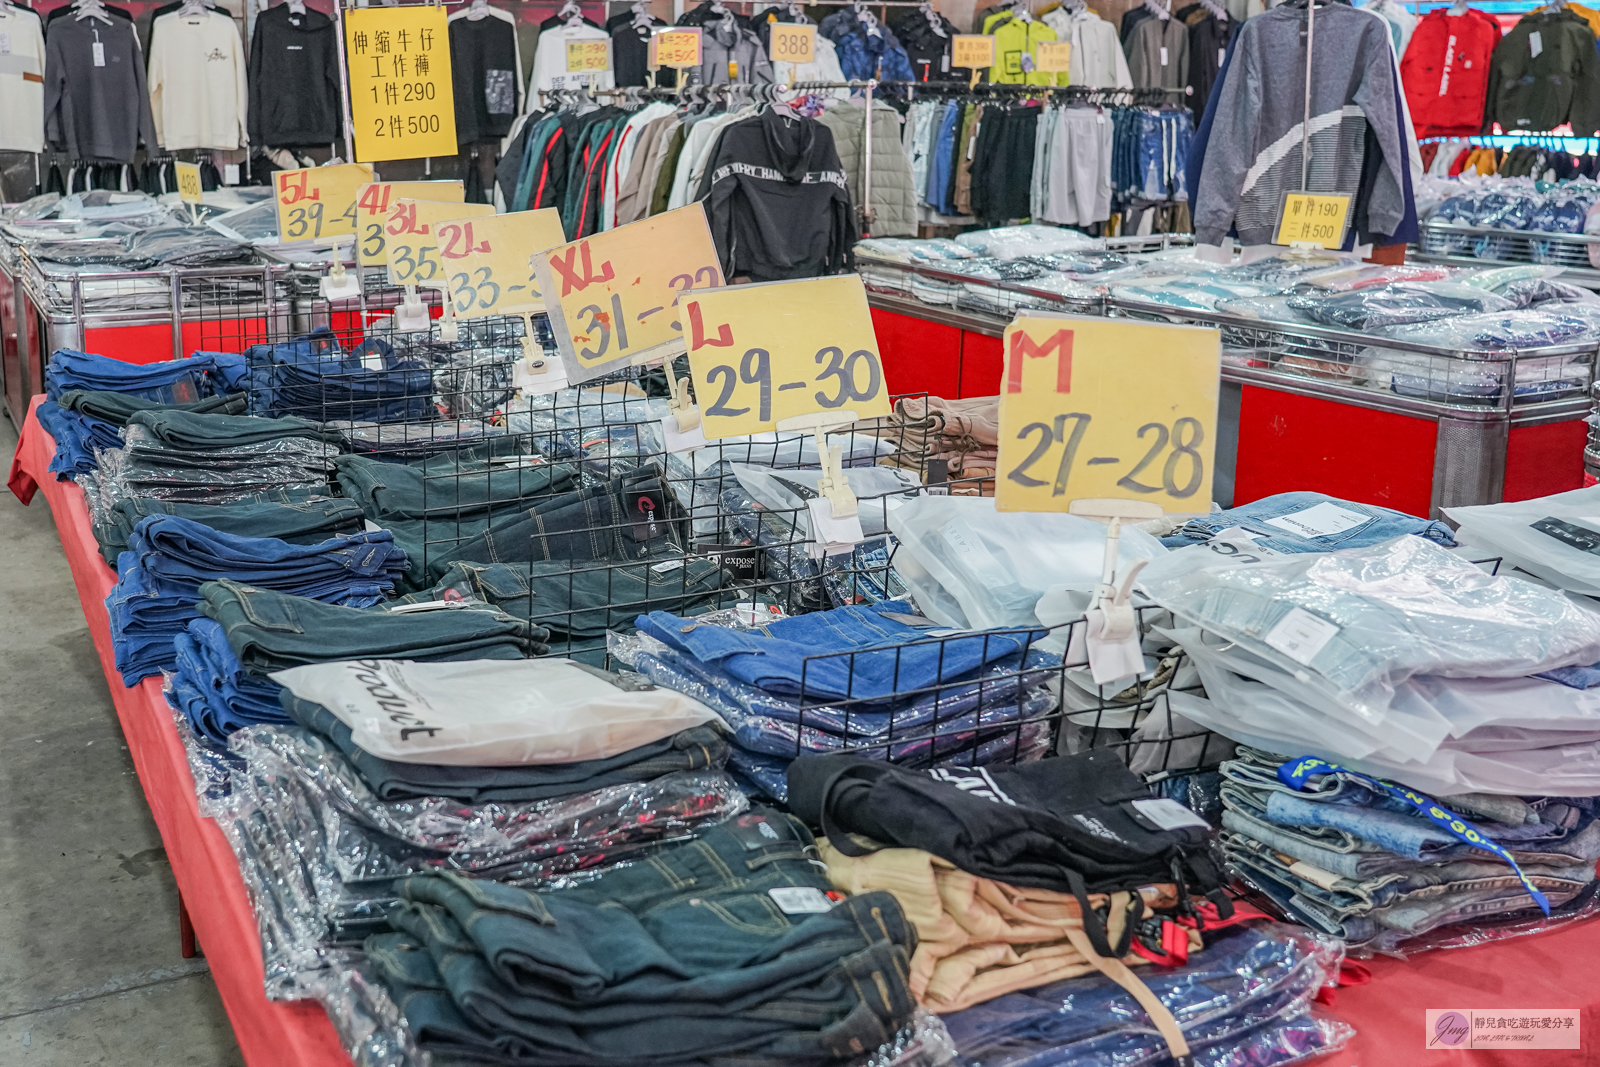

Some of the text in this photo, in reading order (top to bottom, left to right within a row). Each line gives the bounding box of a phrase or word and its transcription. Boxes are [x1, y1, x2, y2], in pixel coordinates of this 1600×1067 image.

[353, 28, 435, 54] 伸縮牛仔
[778, 34, 809, 55] 388
[370, 54, 430, 77] 工作褲
[371, 82, 435, 105] 1件290
[374, 115, 440, 138] 2件500
[182, 174, 199, 196] 488
[280, 171, 320, 205] 5L
[386, 203, 430, 236] 3L
[438, 222, 492, 259] 2L
[549, 240, 616, 298] XL
[687, 300, 734, 352] L
[1007, 329, 1075, 395] M
[705, 345, 881, 422] 29-30
[1007, 412, 1206, 498] 27-28
[724, 556, 756, 569] expose
